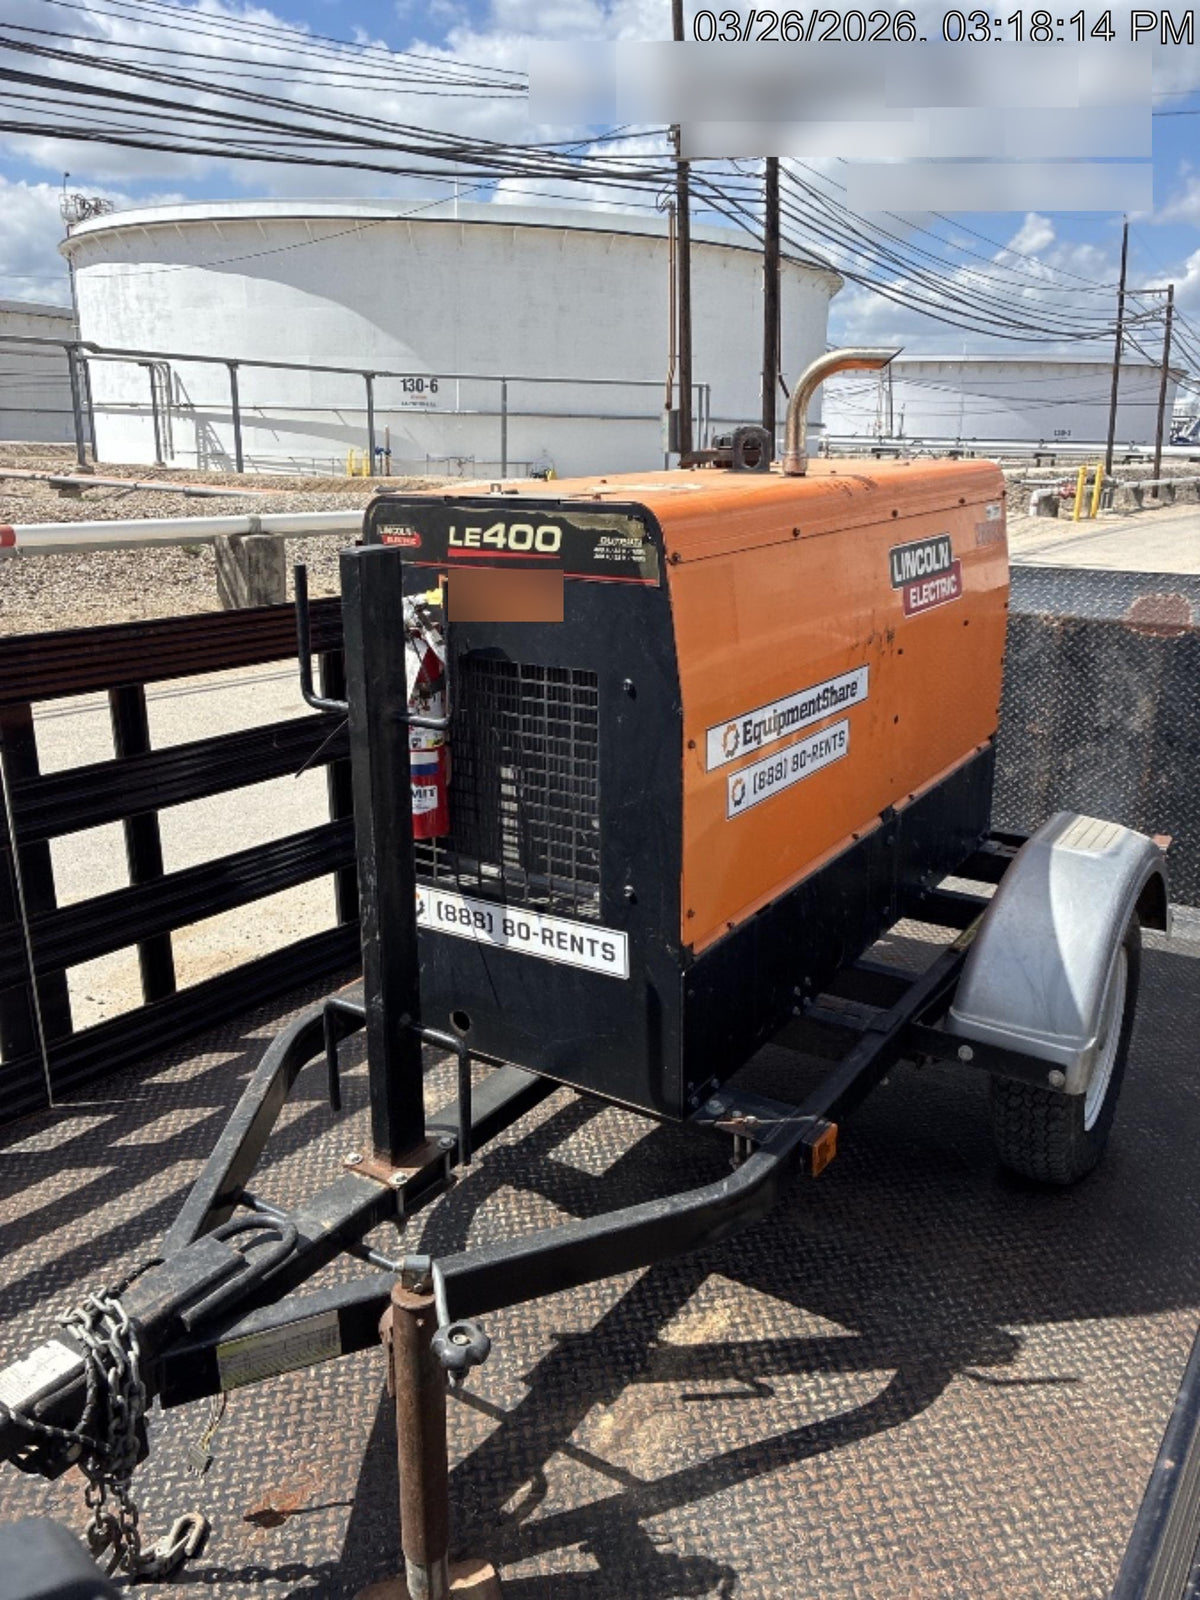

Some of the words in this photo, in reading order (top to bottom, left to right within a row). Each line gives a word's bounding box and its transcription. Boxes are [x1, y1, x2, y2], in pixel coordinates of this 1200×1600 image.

[400, 378, 439, 393] 130-6
[893, 541, 950, 582] LINCOLN
[910, 574, 957, 609] ELECTRIC
[742, 680, 858, 745] EquipmentShare
[791, 730, 846, 772] 80-RENTS
[502, 917, 616, 963] 80-RENTS
